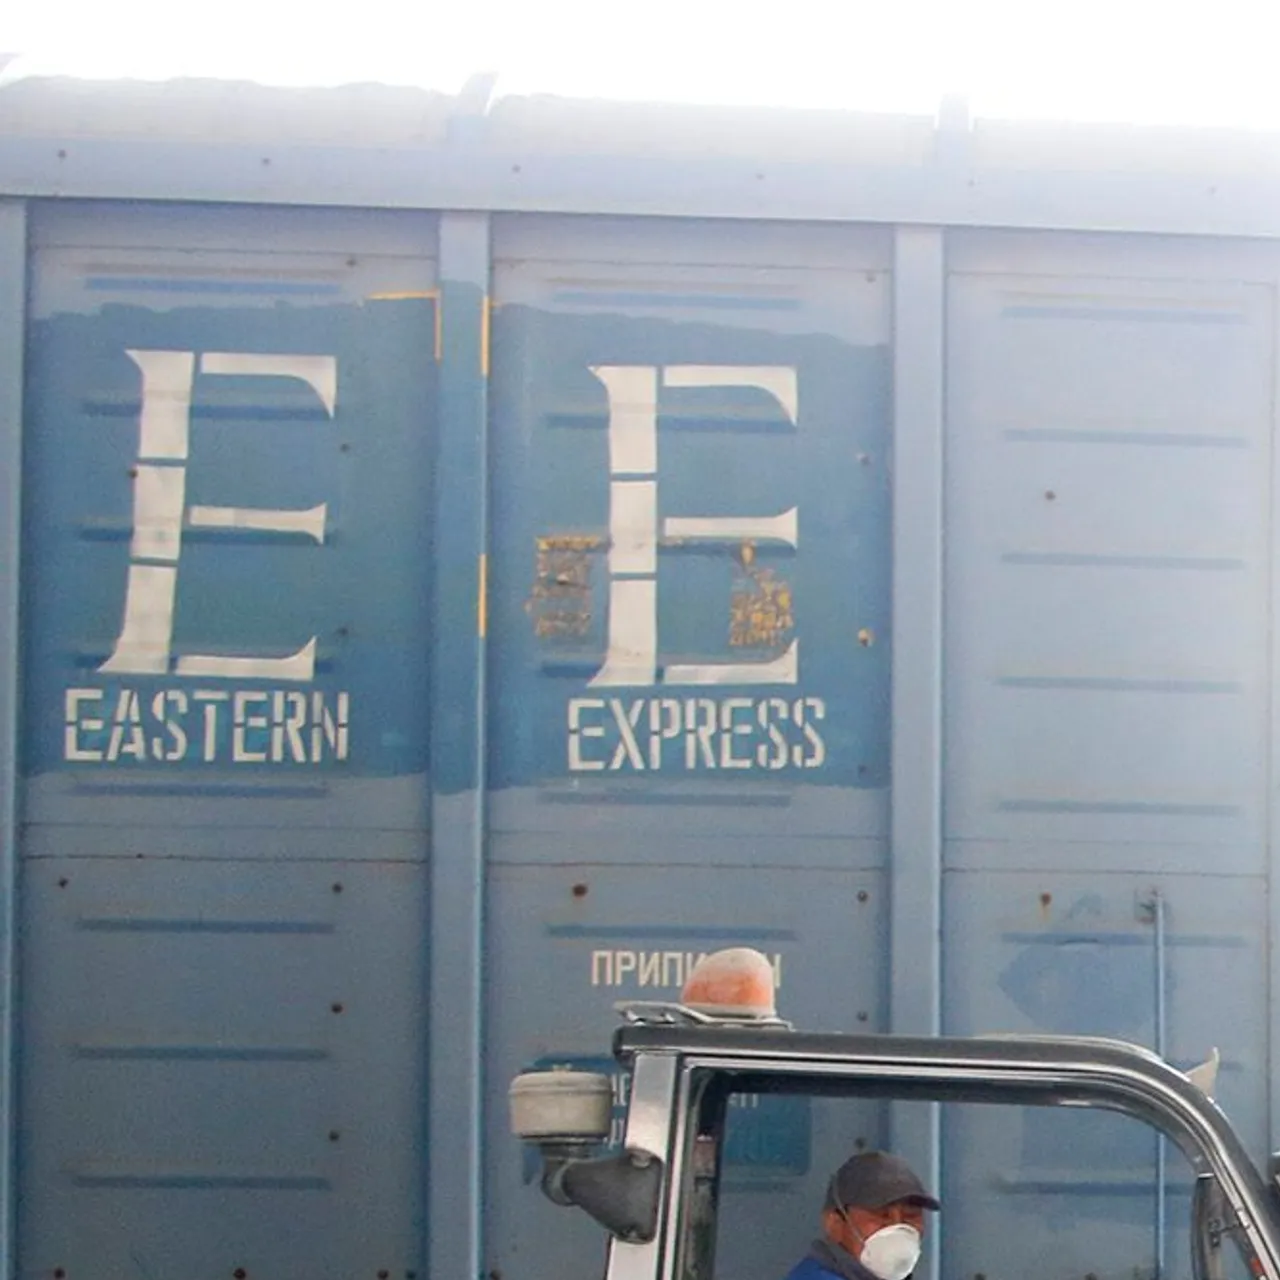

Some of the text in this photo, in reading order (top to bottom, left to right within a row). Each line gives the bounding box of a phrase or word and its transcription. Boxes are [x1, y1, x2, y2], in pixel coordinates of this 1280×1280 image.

[97, 349, 798, 687] E E
[64, 689, 825, 770] EASTERN EXPRESS
